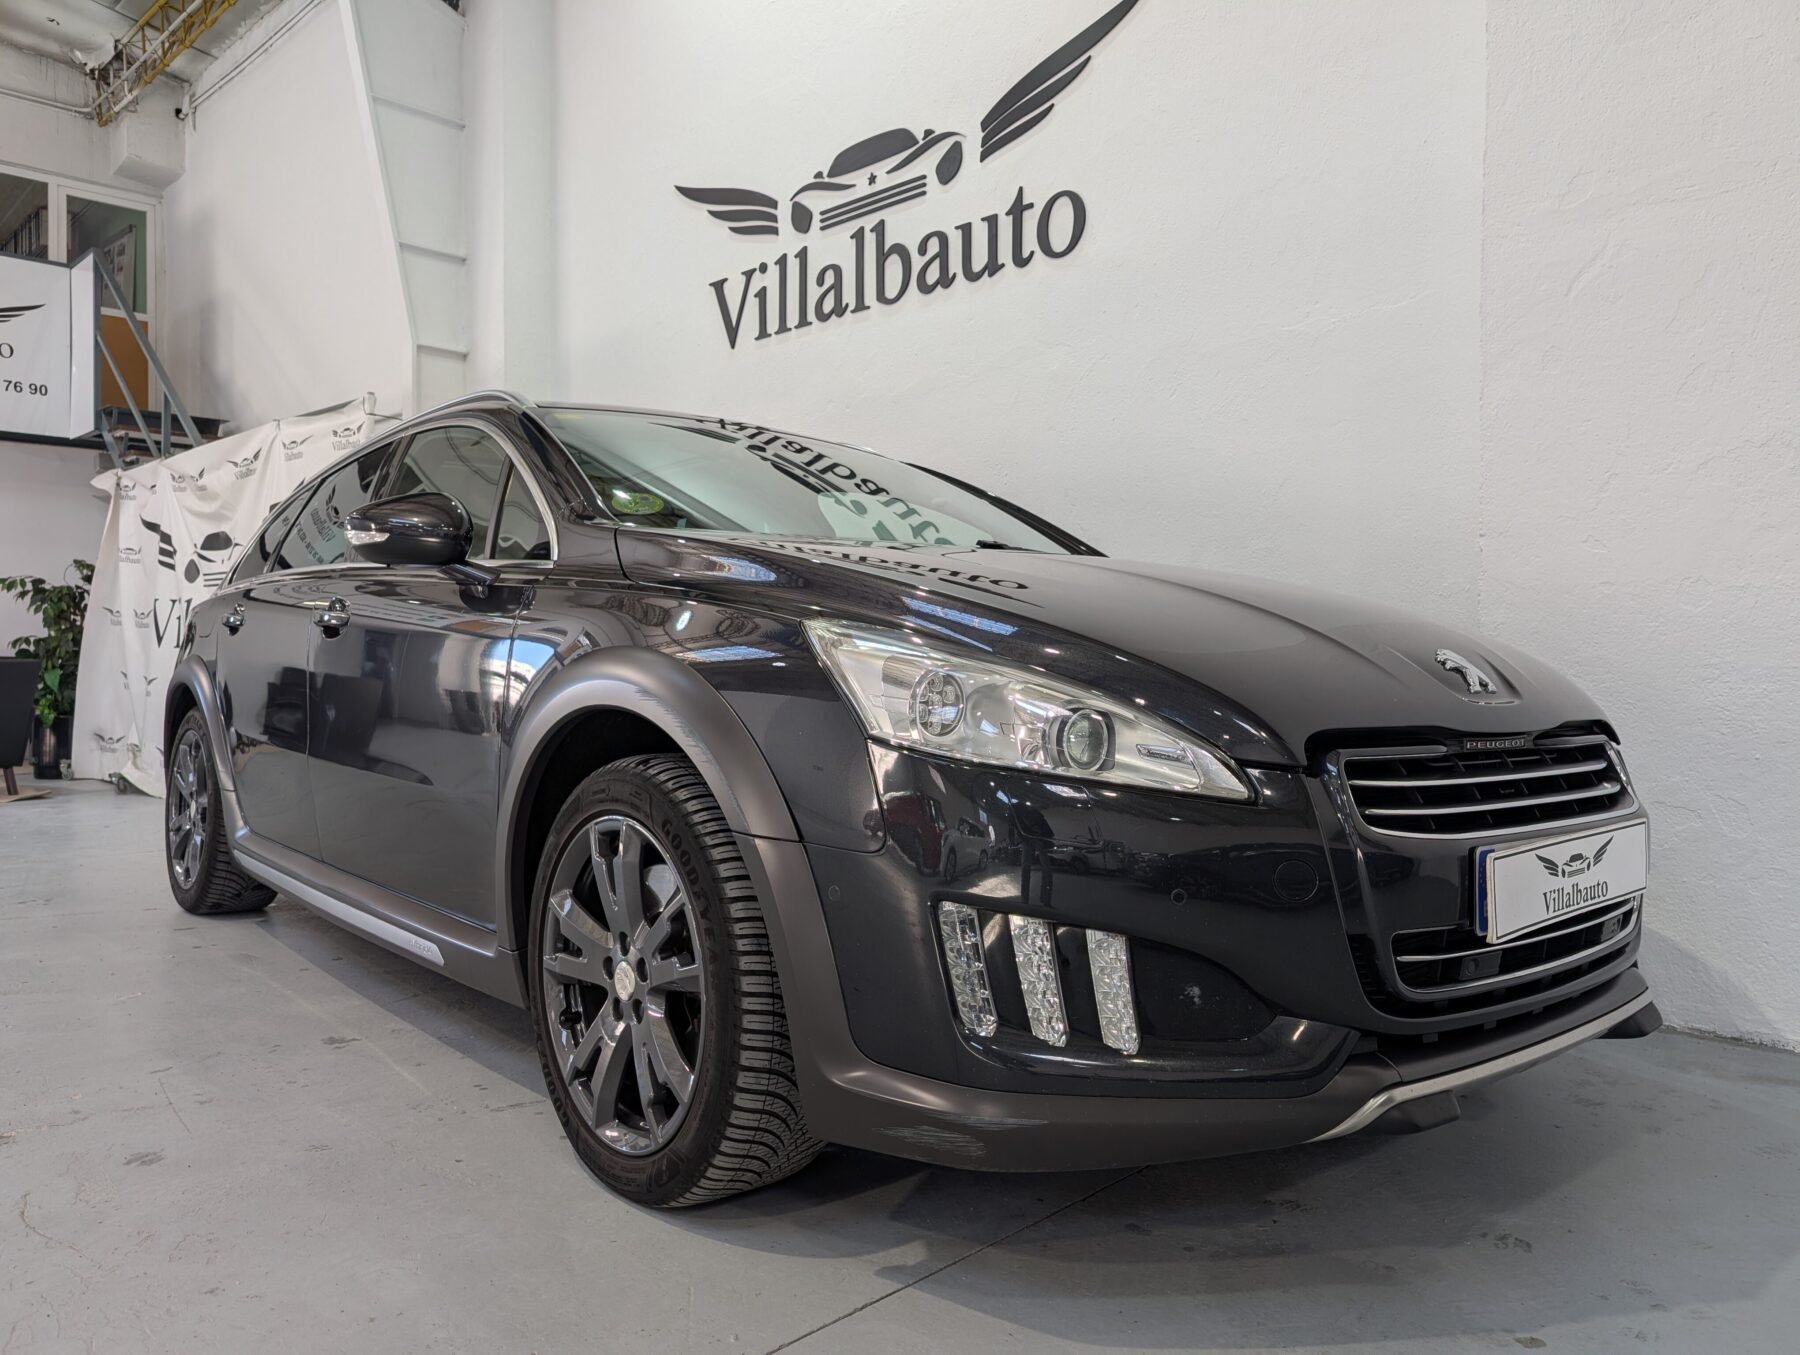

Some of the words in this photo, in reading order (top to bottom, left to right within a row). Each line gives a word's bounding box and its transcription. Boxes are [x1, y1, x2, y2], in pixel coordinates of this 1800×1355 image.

[708, 186, 1087, 350] Villalbauto
[3, 379, 23, 394] 76
[28, 382, 49, 397] 90
[1466, 738, 1526, 750] PEUGEOT
[1542, 880, 1609, 916] Villalbauto
